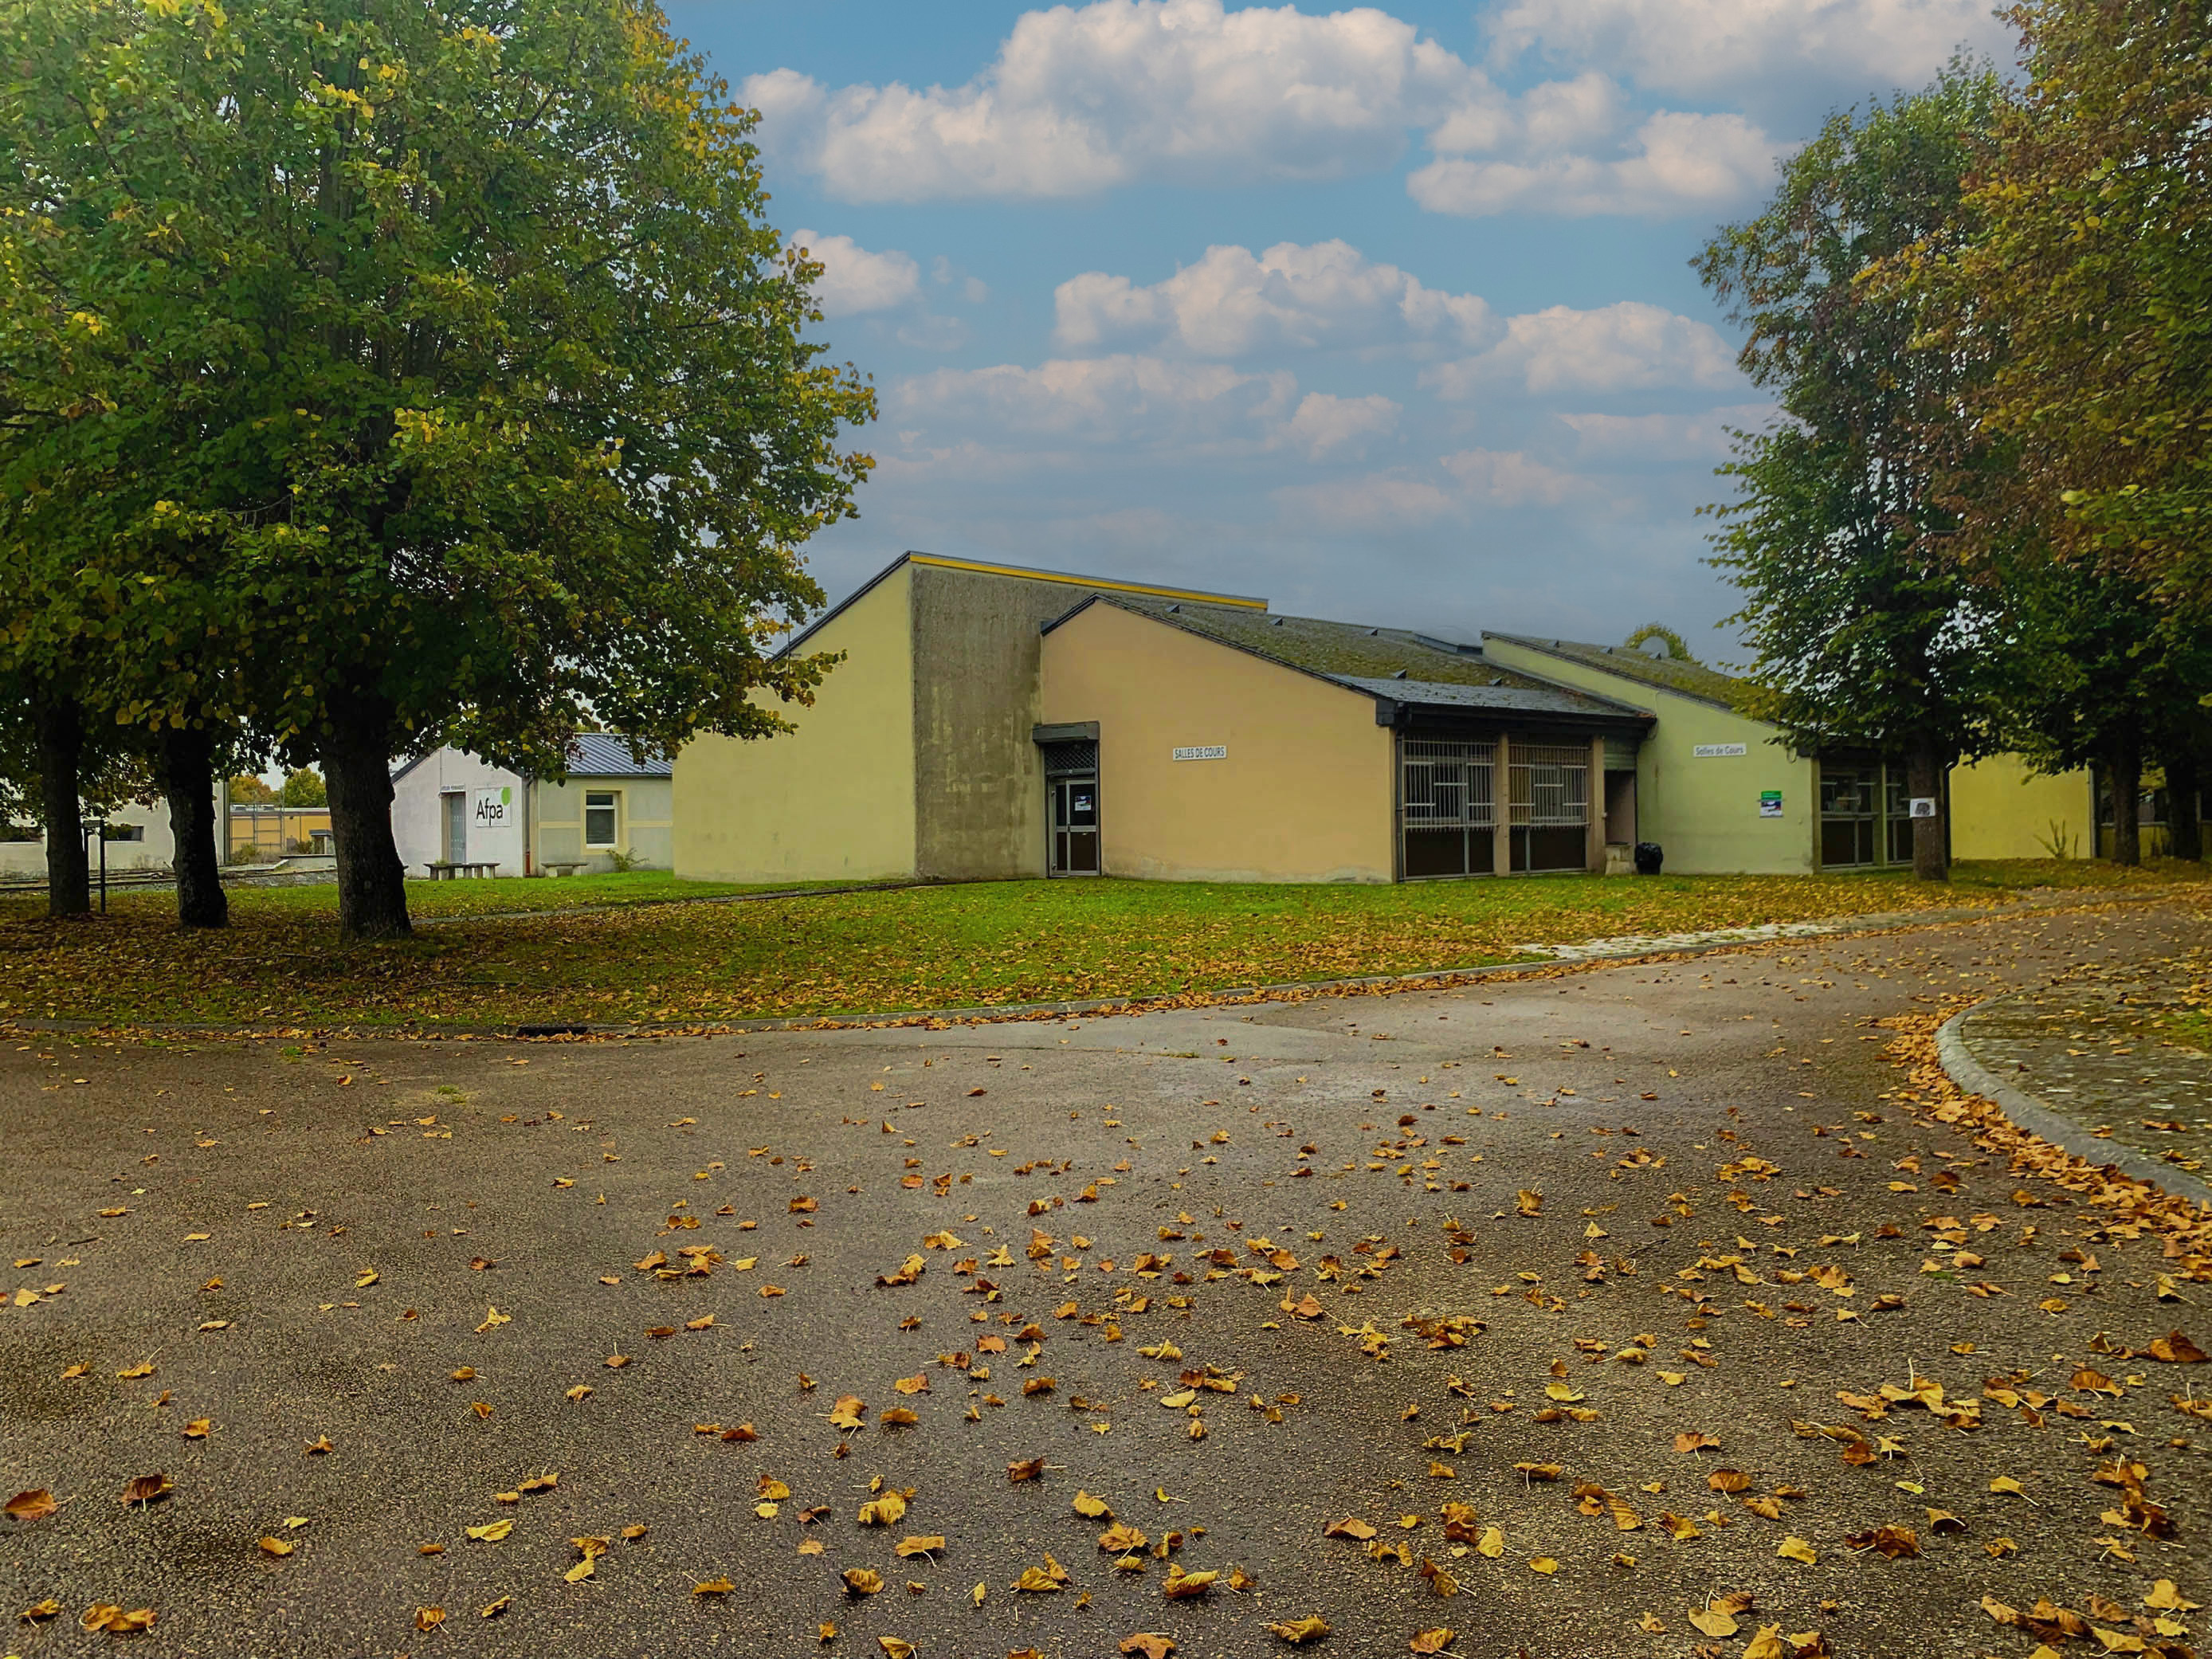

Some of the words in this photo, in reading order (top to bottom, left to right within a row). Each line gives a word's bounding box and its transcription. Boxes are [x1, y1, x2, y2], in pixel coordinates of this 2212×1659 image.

[1175, 748, 1194, 759] SALLES
[1195, 747, 1204, 758] DE
[1204, 747, 1225, 758] COURS
[1696, 747, 1715, 756] Salles
[1716, 746, 1723, 755] de
[1724, 745, 1743, 755] Cours
[476, 798, 504, 827] Afpa
